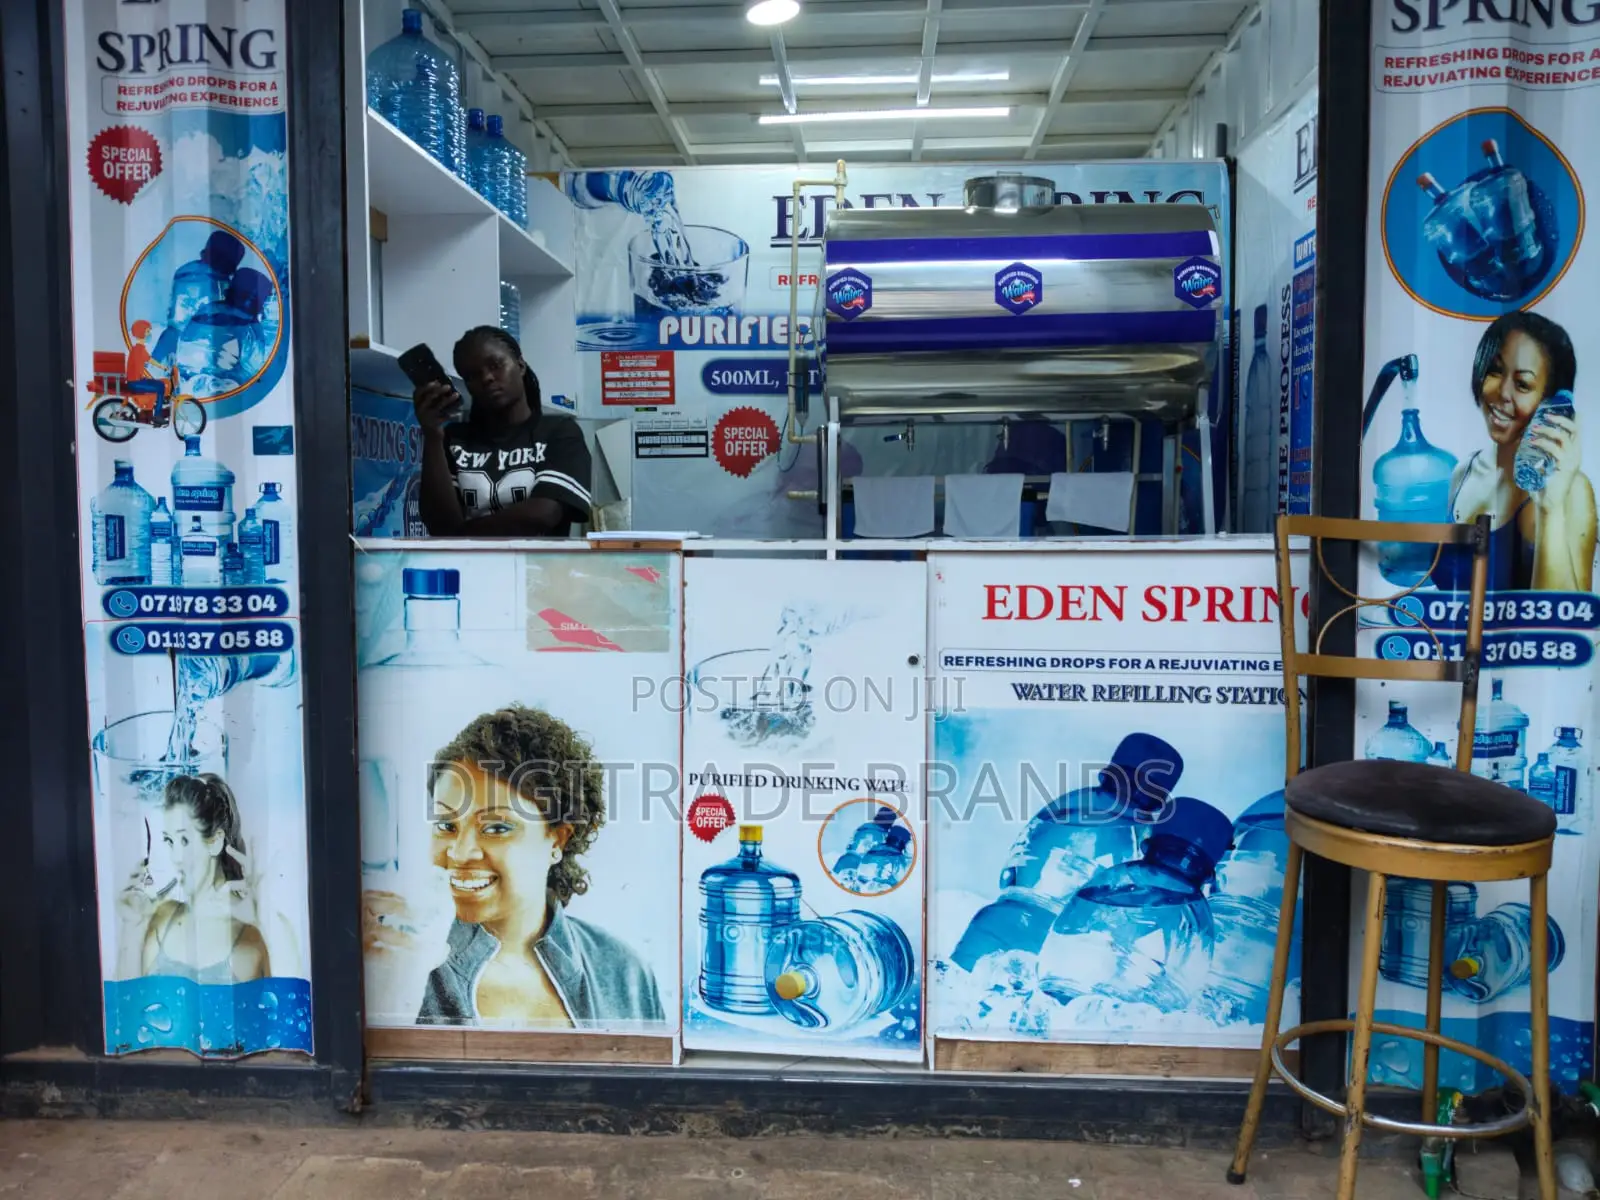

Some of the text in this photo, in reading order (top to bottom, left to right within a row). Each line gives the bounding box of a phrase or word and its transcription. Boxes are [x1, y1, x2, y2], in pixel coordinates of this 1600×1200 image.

[97, 24, 276, 73] SPRING
[1384, 47, 1600, 69] REFRESHING DROPS FOR A
[188, 76, 236, 91] DROPS
[240, 81, 266, 91] FOR
[270, 81, 277, 91] A
[1383, 66, 1600, 87] REJUVIATING EXPERIENCE
[191, 91, 279, 107] EXPERIENCE
[101, 145, 152, 162] SPECIAL
[103, 162, 151, 181] OFFER
[711, 370, 780, 388] 500ML,
[724, 427, 769, 440] SPECIAL
[498, 442, 547, 471] YORK
[725, 441, 768, 457] OFFER
[212, 595, 243, 614] 33
[247, 594, 277, 613] 04
[982, 585, 1127, 622] EDEN
[1520, 600, 1552, 621] 33
[1557, 601, 1593, 622] 04
[219, 631, 250, 649] 05
[255, 628, 284, 647] 88
[1542, 641, 1577, 661] 88
[944, 655, 1046, 668] REFRESHING
[1050, 655, 1105, 669] DROPS
[1109, 657, 1142, 670] FOR
[1144, 658, 1156, 670] A
[1158, 657, 1271, 671] REJUVIATING
[1011, 682, 1086, 702] WATER
[1092, 683, 1213, 704] REFILLING
[688, 772, 768, 788] PURIFIED
[772, 774, 860, 792] DRINKING
[695, 806, 728, 817] SPECIAL
[696, 816, 727, 829] OFFER
